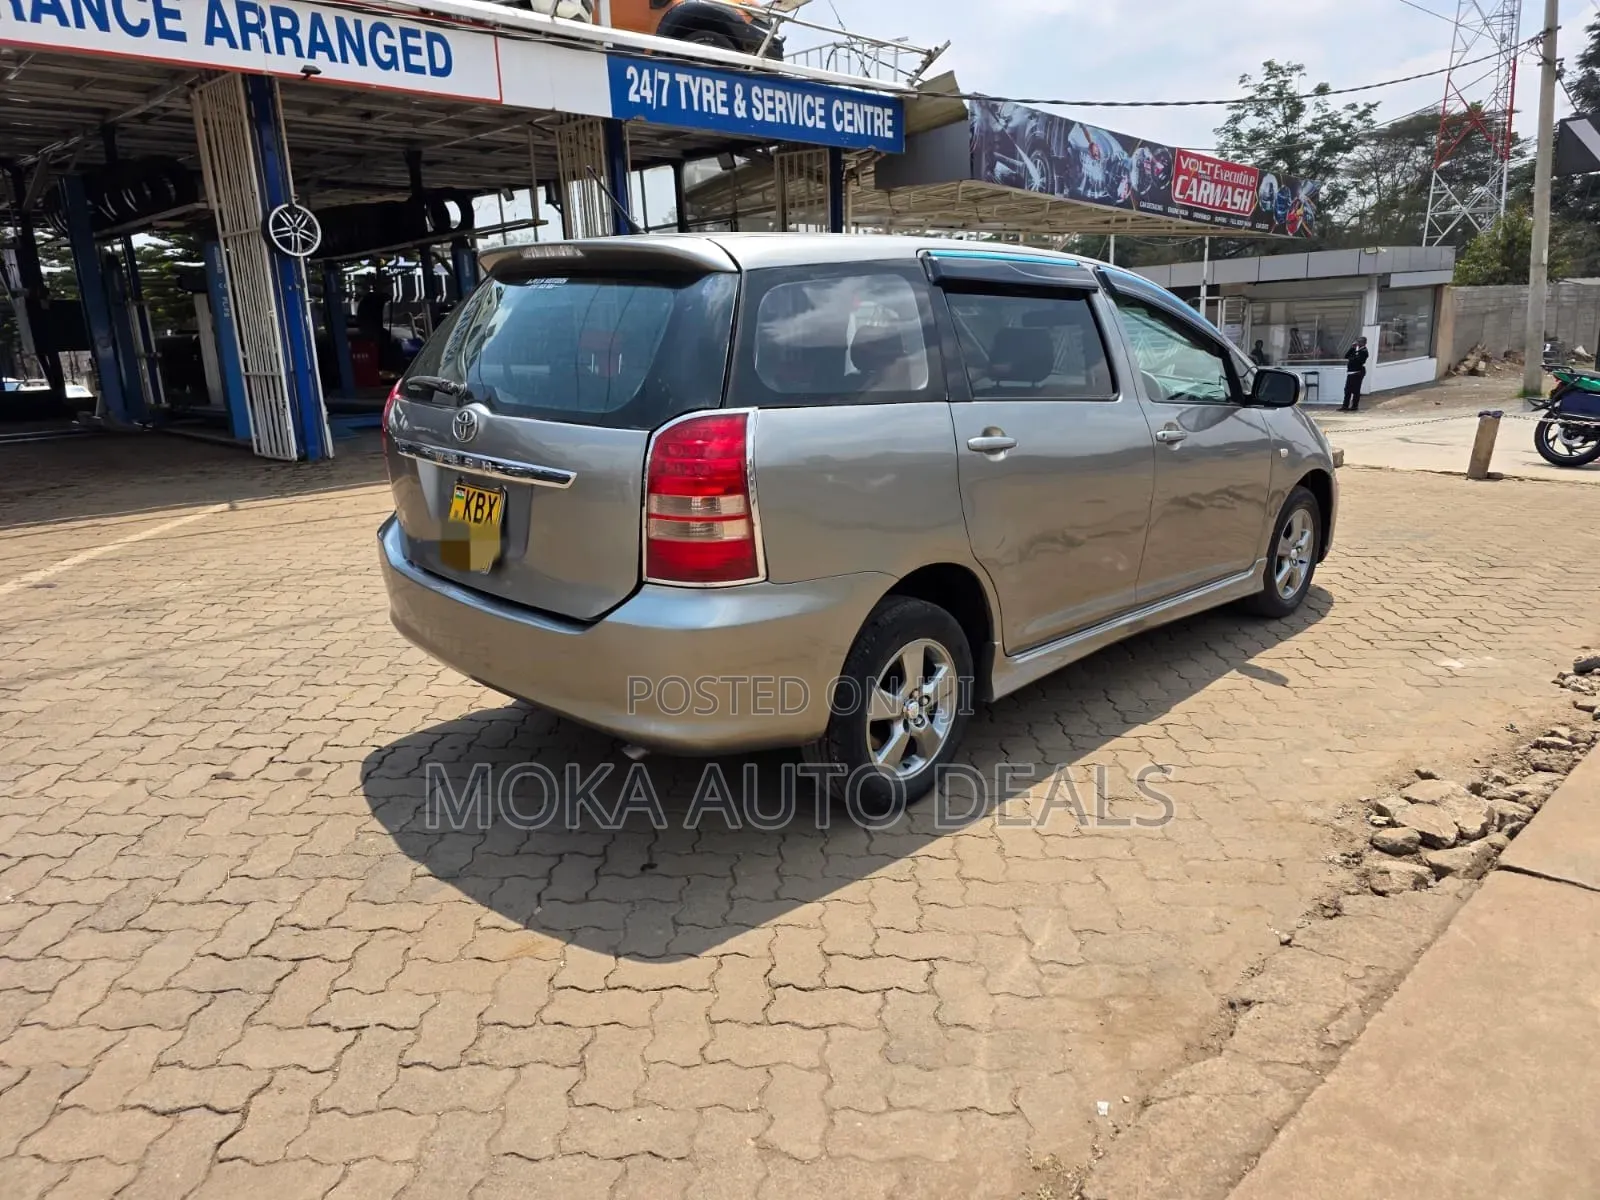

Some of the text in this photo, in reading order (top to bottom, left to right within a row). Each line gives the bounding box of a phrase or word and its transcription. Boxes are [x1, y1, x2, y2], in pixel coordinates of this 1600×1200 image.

[204, 0, 454, 78] ARRANGED
[626, 65, 894, 138] 24/7 TYRE & SERVICE CENTRE
[1180, 155, 1215, 175] VOLT
[1174, 175, 1253, 211] CARWASH
[463, 489, 498, 524] KBX
